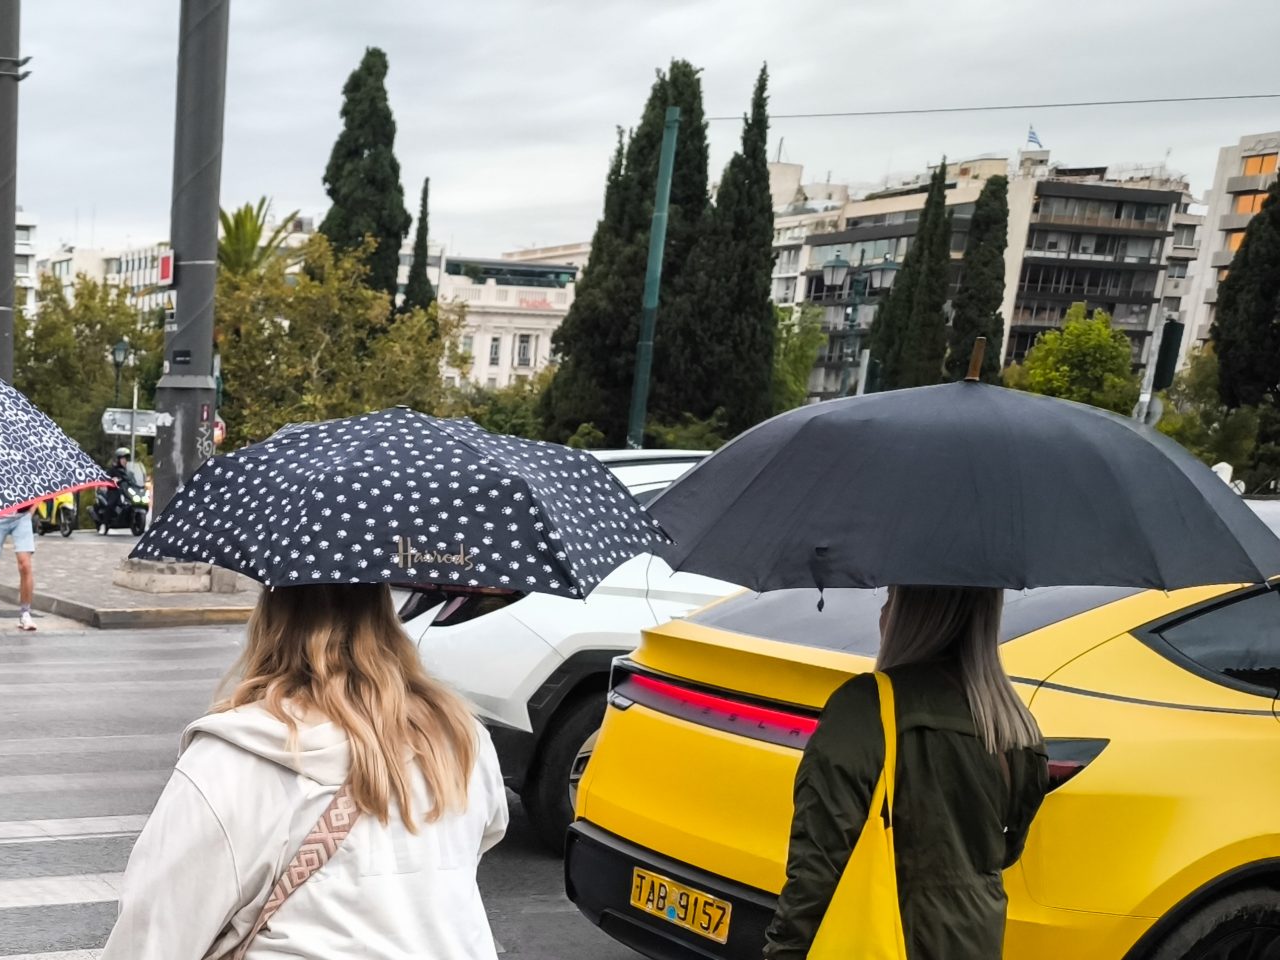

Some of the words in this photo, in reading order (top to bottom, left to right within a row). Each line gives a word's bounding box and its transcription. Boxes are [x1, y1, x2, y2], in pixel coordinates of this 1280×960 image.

[389, 536, 474, 571] Harrods
[679, 700, 802, 737] TESLA
[677, 892, 726, 934] 9157
